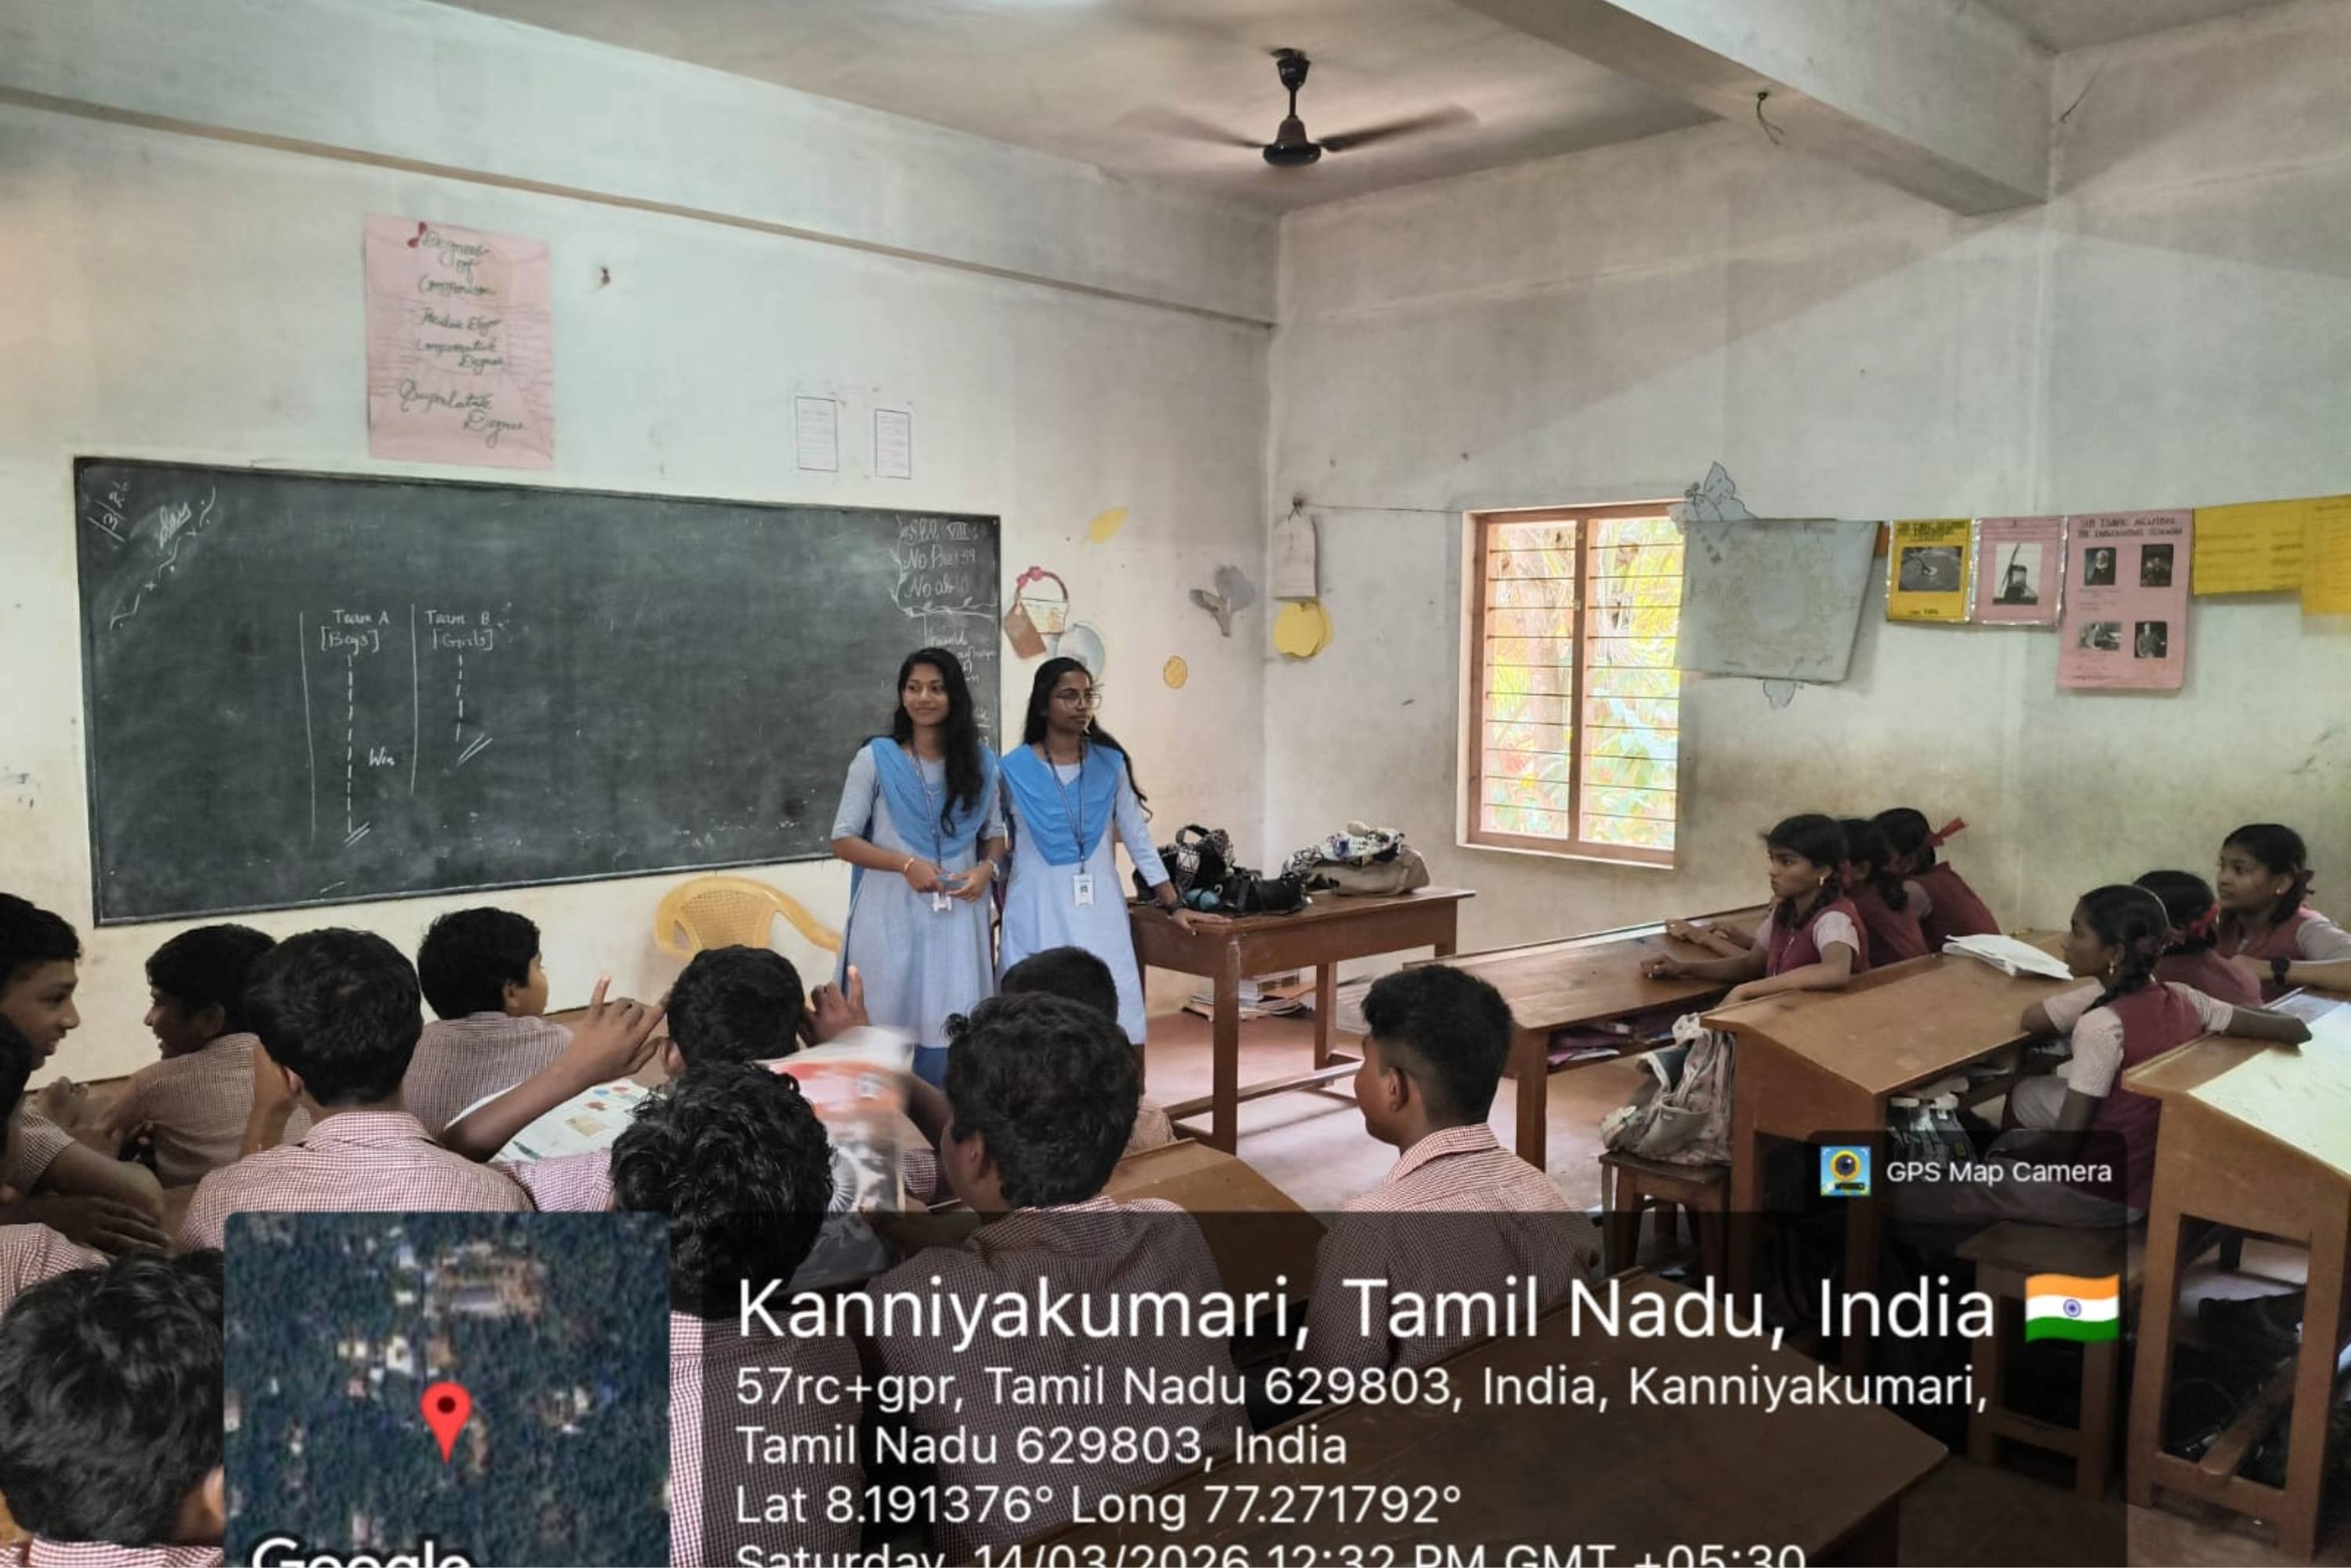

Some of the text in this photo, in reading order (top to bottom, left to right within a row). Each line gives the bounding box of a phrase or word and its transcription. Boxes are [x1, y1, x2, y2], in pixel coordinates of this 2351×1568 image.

[332, 610, 389, 625] Team A
[480, 611, 490, 625] B
